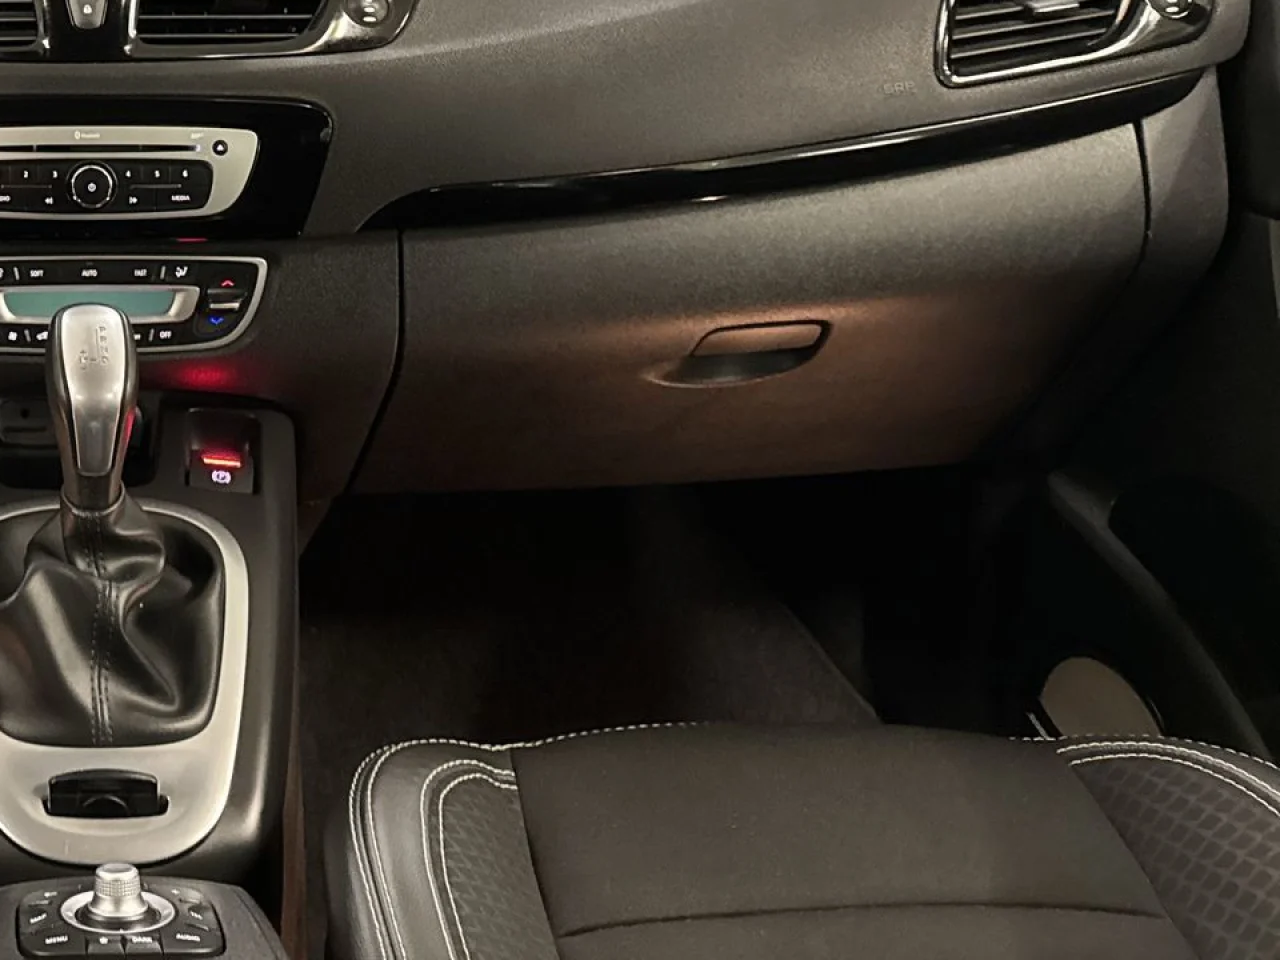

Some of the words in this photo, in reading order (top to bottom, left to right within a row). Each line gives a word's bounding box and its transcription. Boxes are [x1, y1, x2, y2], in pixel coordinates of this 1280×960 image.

[171, 194, 191, 202] MEDIA
[81, 269, 98, 277] AUTO
[160, 330, 172, 339] OFF
